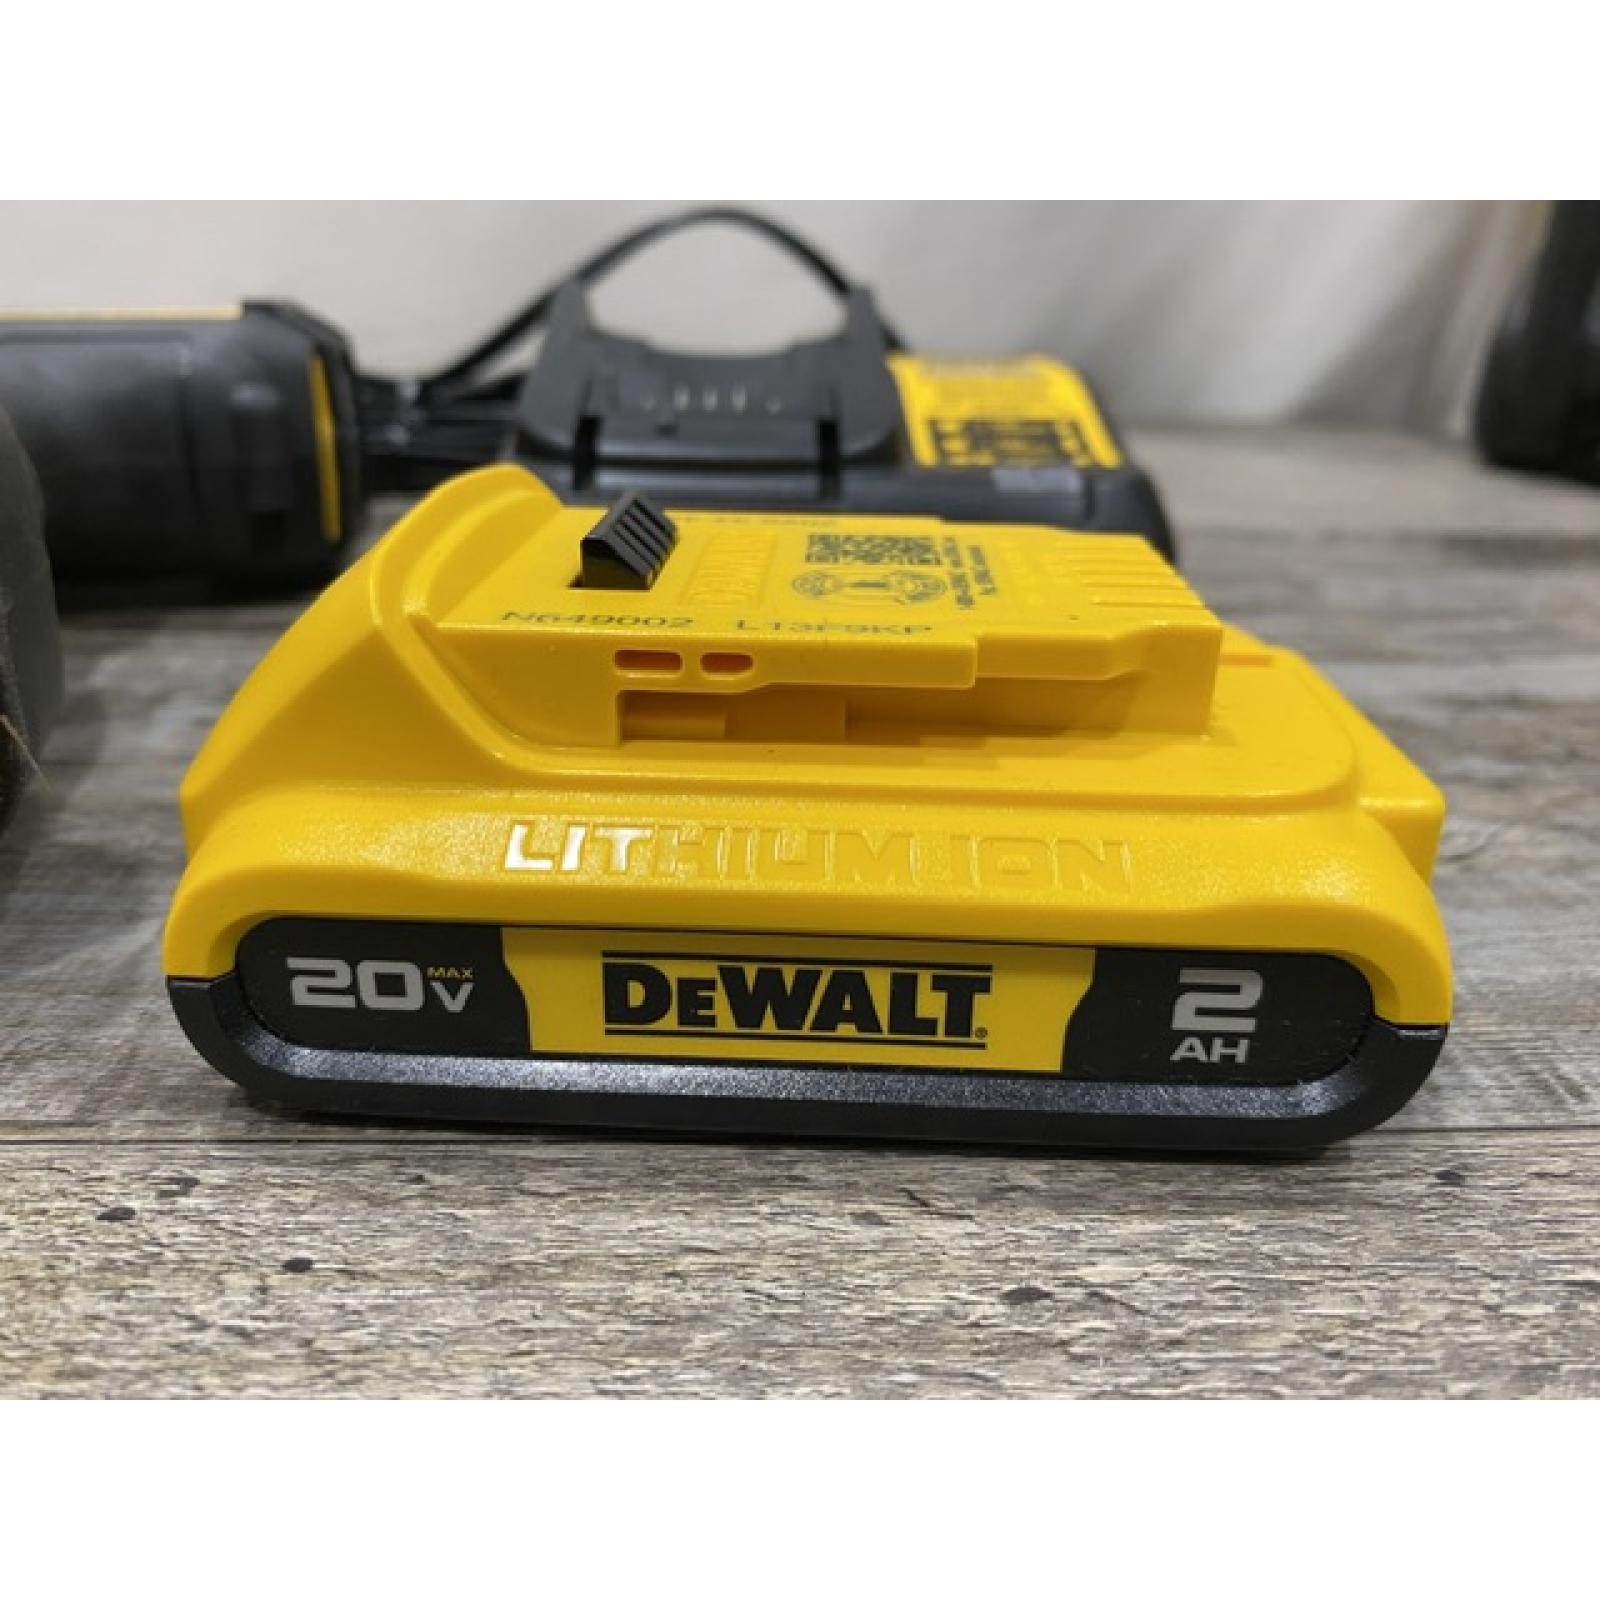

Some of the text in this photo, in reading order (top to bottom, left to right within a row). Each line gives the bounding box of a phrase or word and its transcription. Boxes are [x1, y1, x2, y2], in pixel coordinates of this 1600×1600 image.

[504, 820, 1131, 890] LITHIUM ION
[426, 966, 474, 979] MAX
[1171, 968, 1263, 1033] 2
[1169, 1037, 1250, 1063] AH
